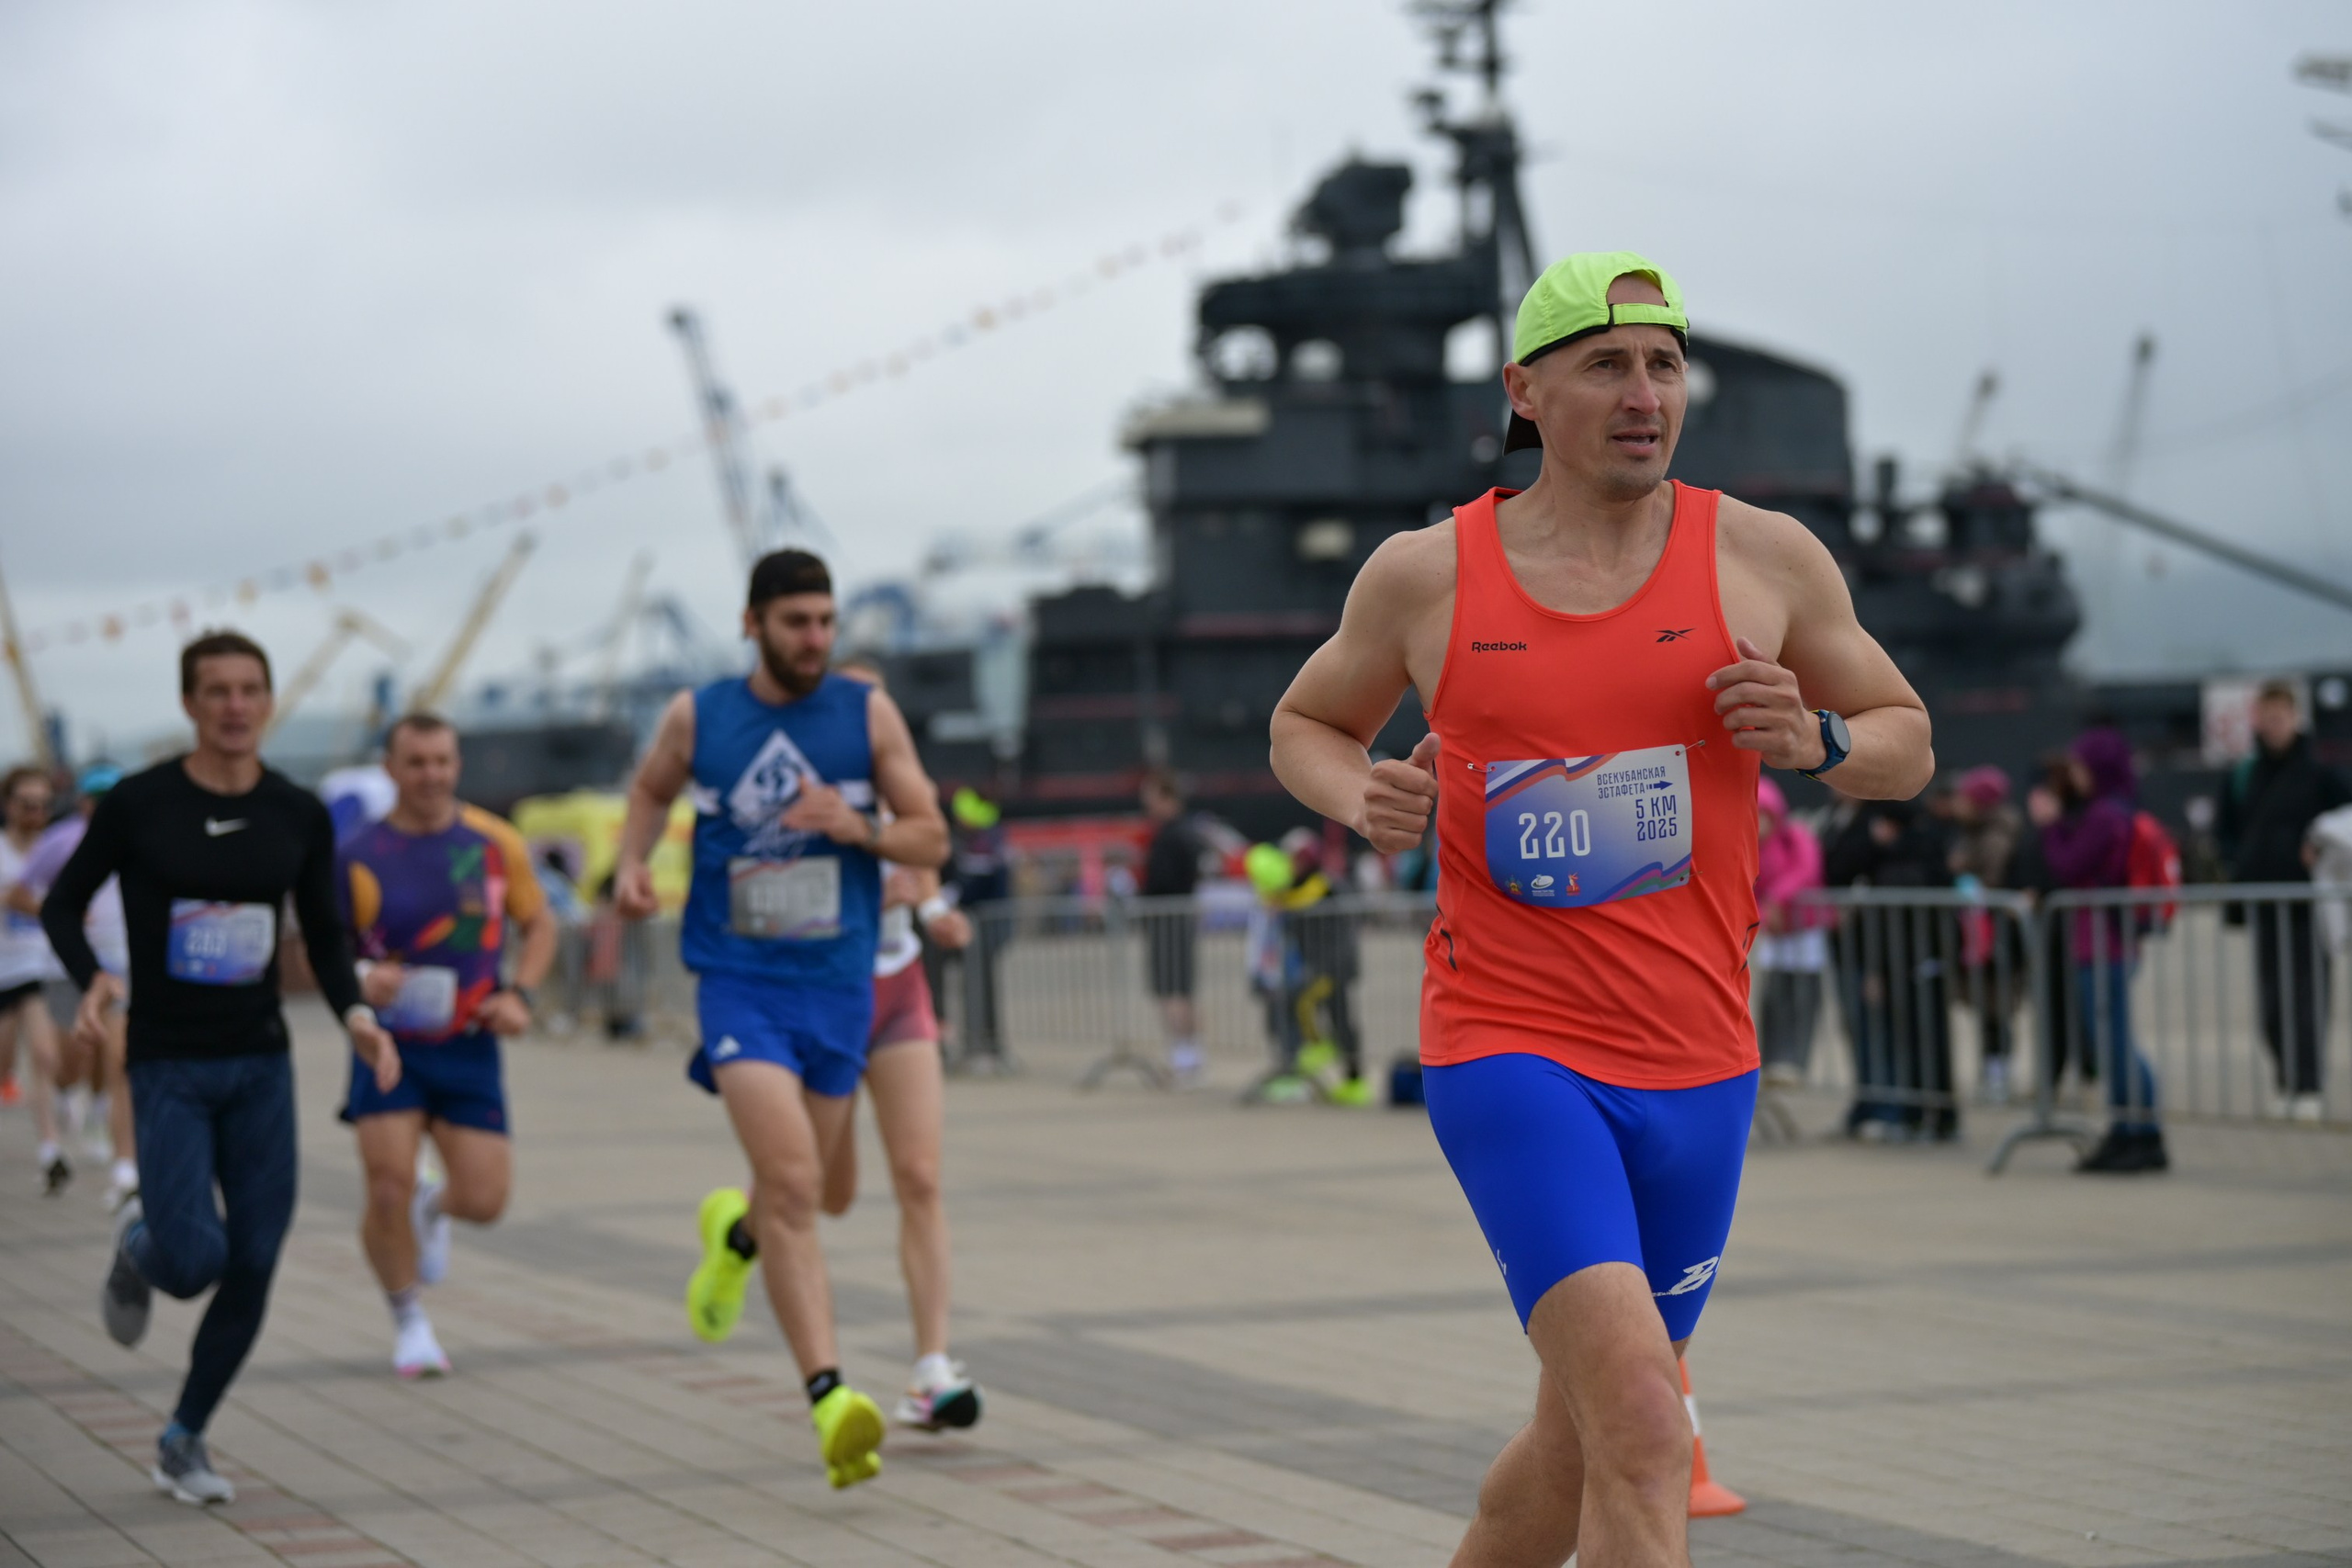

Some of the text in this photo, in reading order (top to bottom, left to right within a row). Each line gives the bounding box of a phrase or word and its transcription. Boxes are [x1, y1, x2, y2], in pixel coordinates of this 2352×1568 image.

[1472, 641, 1527, 653] Reebok
[1597, 766, 1666, 785] ВСЕКУБАНСКАЯ
[1598, 783, 1645, 799] ЭСТАФЕТА
[1635, 795, 1677, 819] 5 КМ
[1519, 809, 1590, 860] 220
[1636, 817, 1678, 841] 2025
